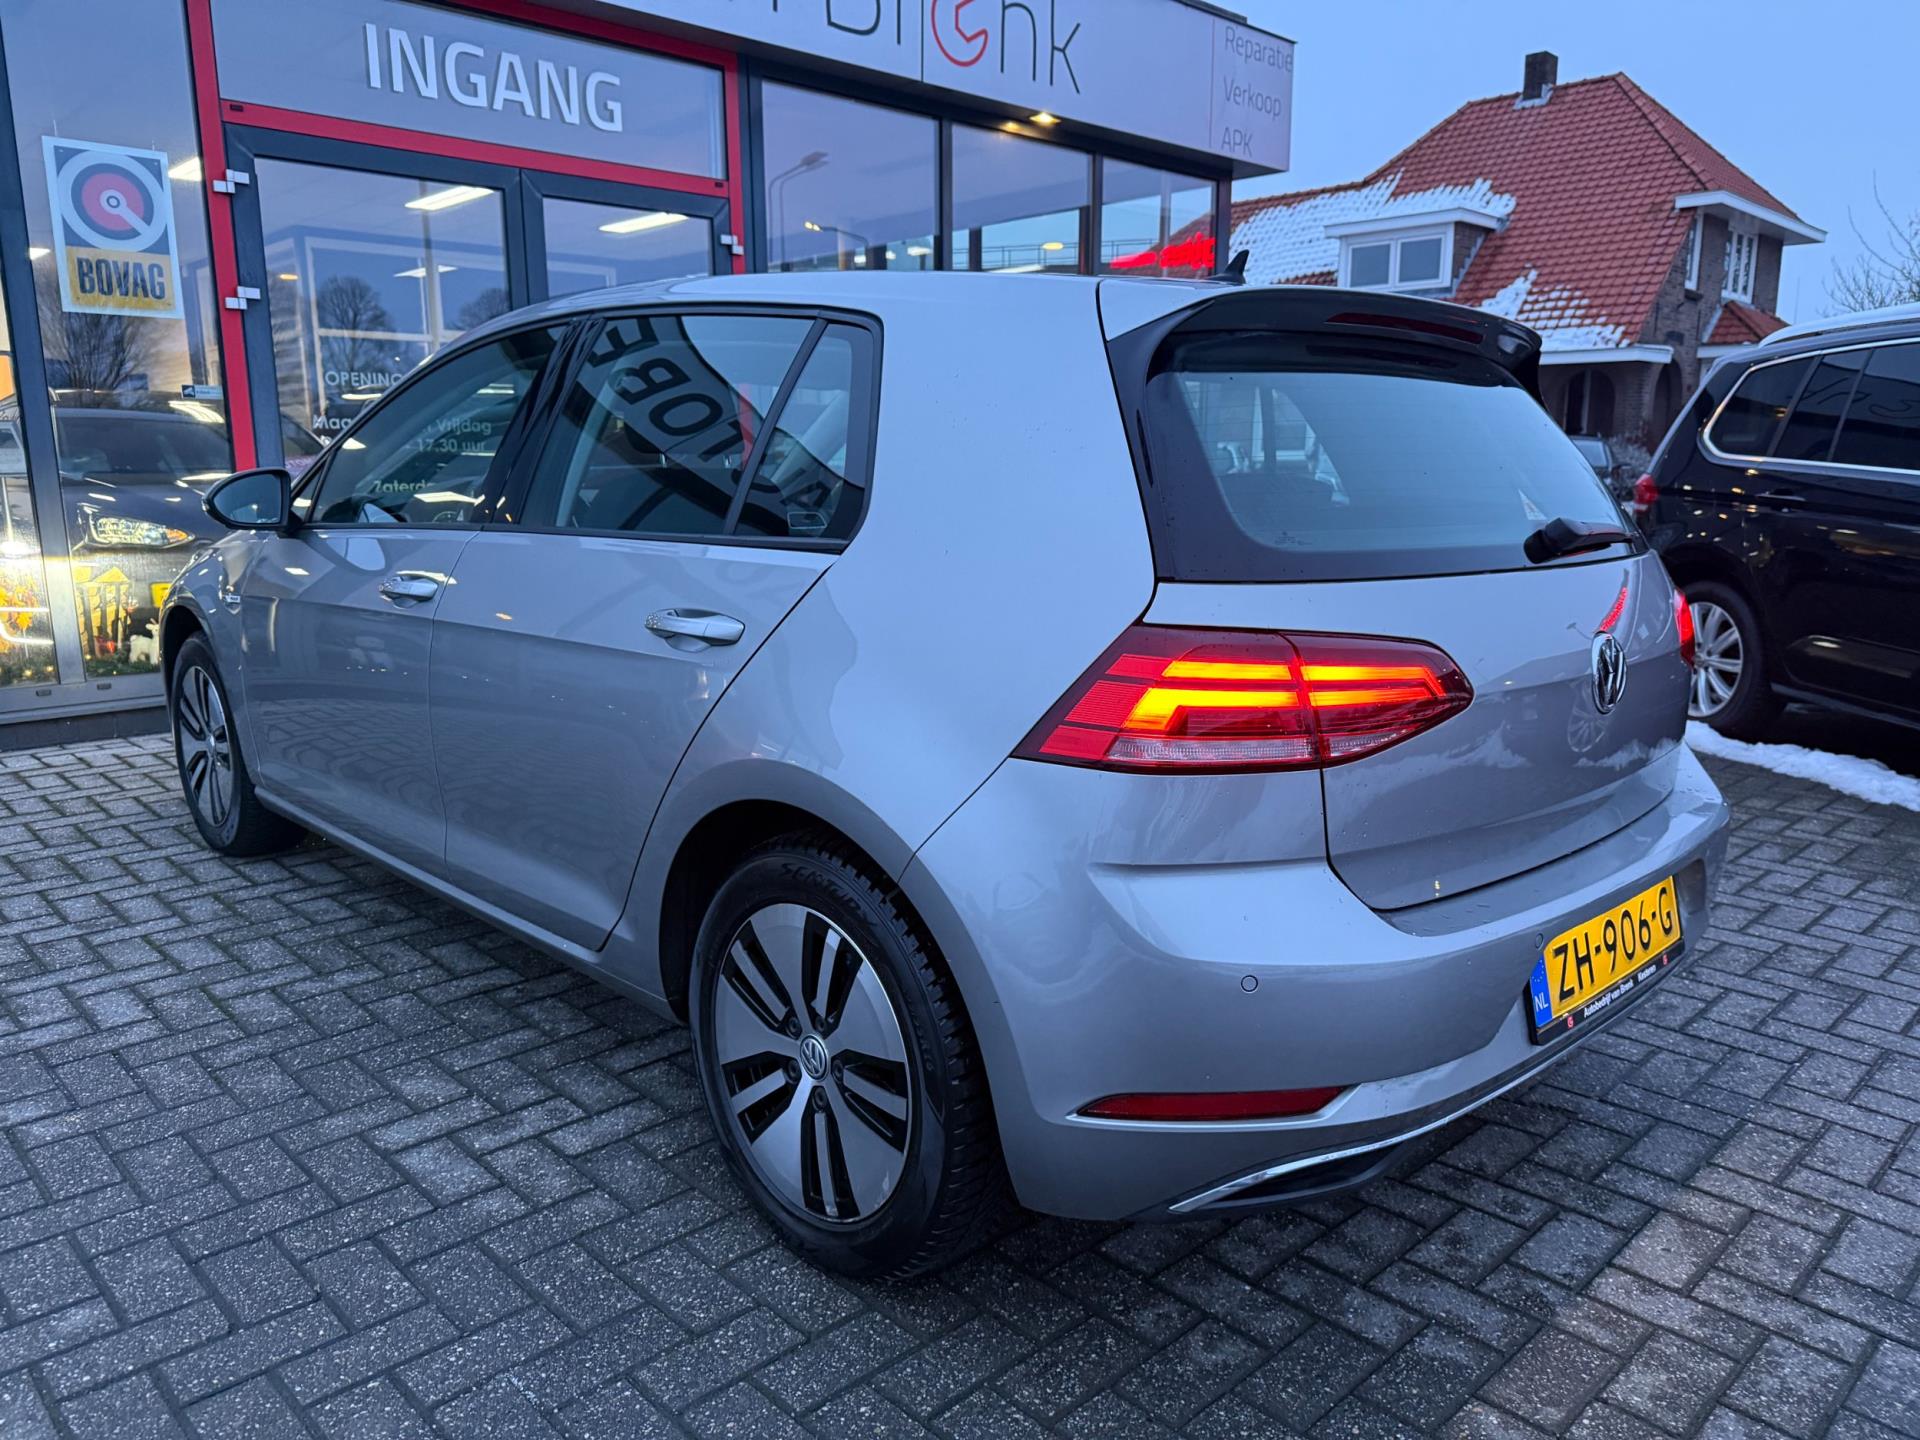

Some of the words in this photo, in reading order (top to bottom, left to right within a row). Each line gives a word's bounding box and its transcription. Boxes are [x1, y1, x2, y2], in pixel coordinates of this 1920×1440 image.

[1225, 26, 1293, 73] Reparatie
[365, 23, 623, 132] INGANG
[1223, 75, 1281, 121] Verkoop
[1221, 126, 1253, 157] APK
[76, 257, 166, 300] BOVAG
[436, 418, 492, 435] Vrijdag
[1552, 886, 1673, 1003] ZH-906-G
[1534, 992, 1549, 1012] NL
